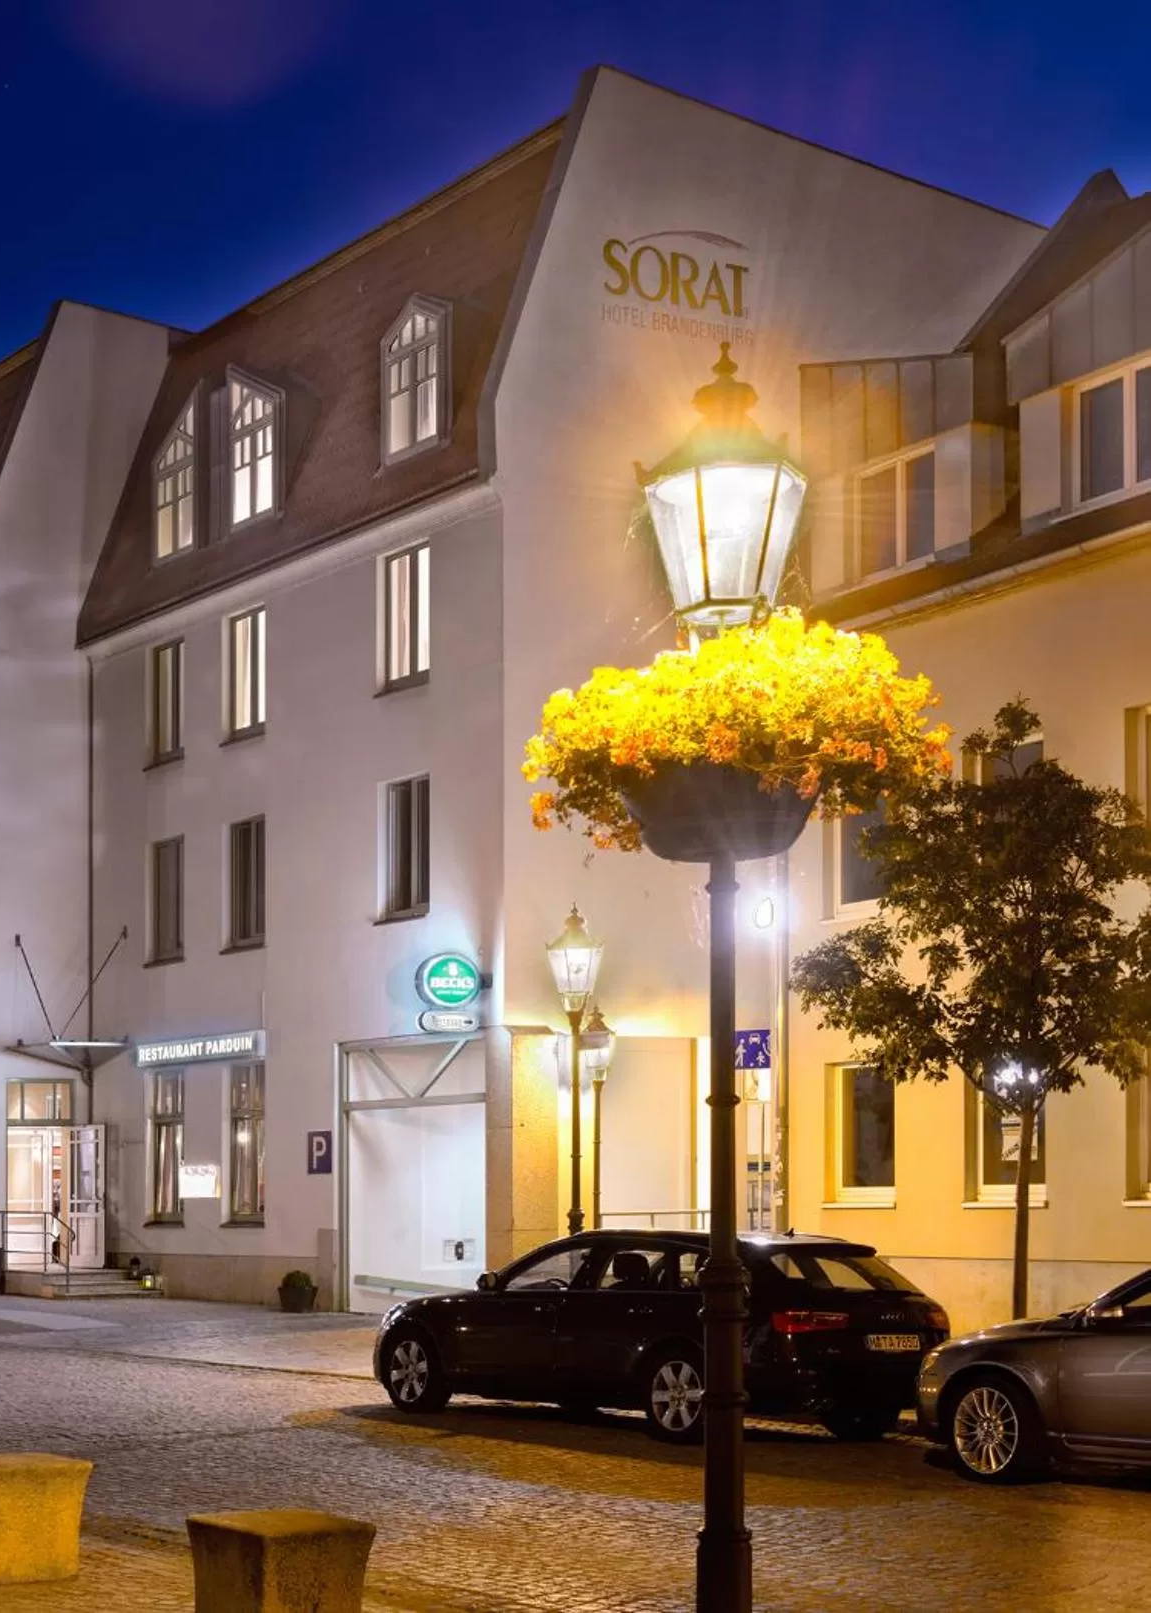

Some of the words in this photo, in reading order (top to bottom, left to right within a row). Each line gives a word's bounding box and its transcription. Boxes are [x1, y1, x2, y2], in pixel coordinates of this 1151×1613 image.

[602, 238, 750, 317] SORAT
[601, 303, 647, 329] HOTEL
[137, 1041, 203, 1062] RESTAURANT
[205, 1036, 253, 1056] PARDUIN
[312, 1135, 327, 1170] P
